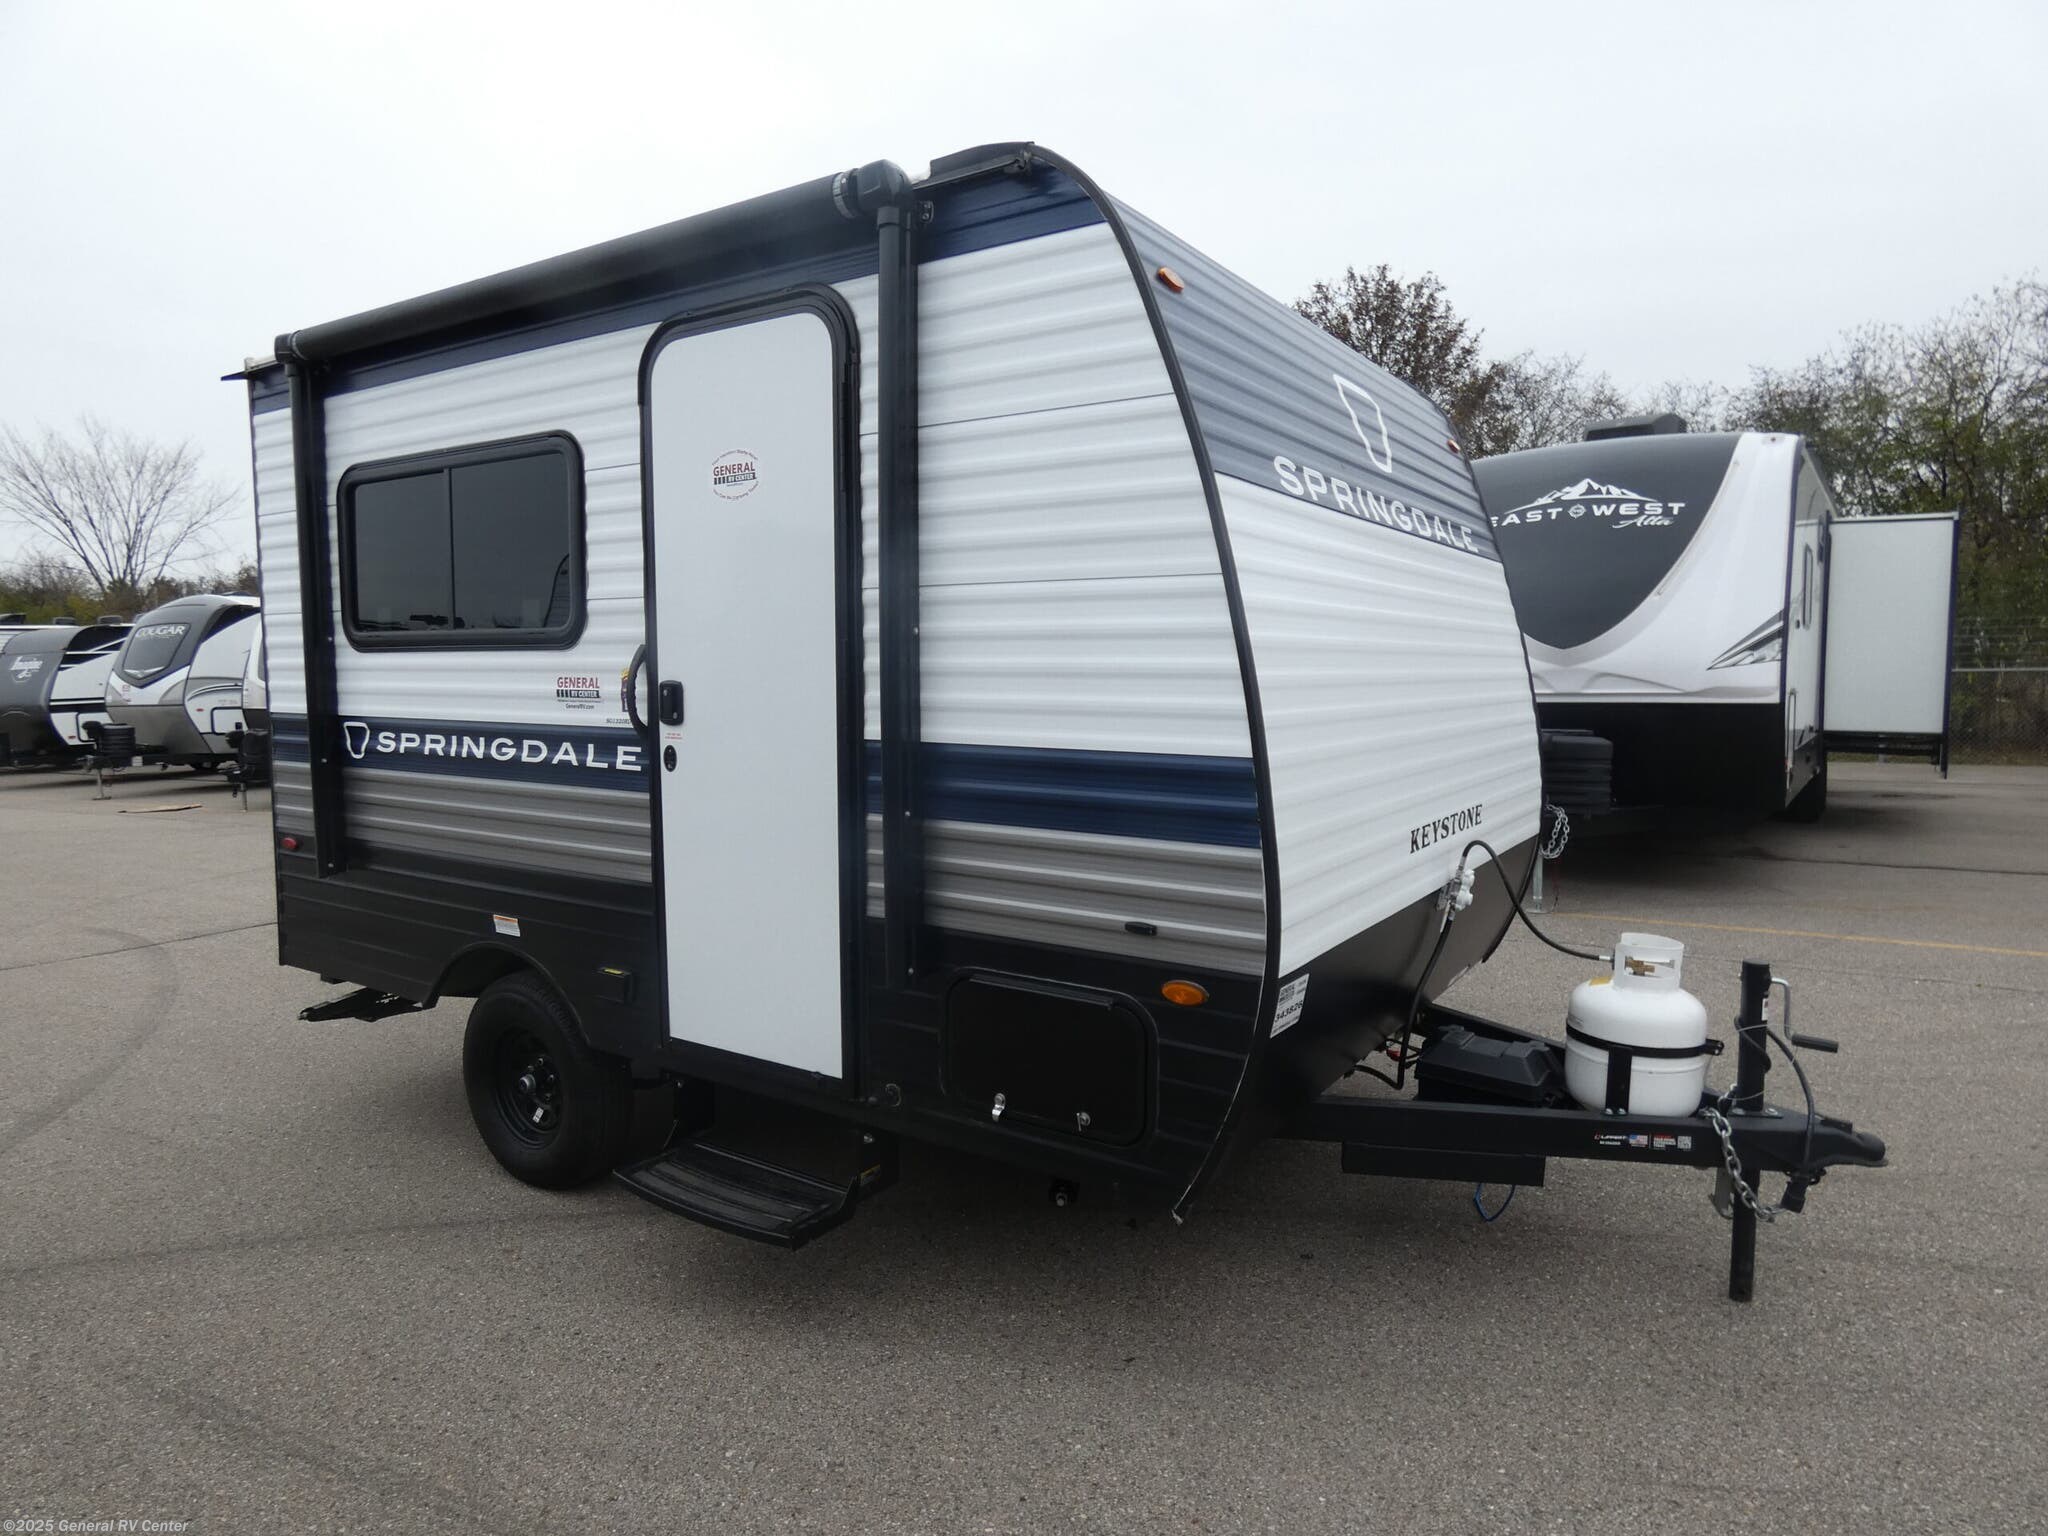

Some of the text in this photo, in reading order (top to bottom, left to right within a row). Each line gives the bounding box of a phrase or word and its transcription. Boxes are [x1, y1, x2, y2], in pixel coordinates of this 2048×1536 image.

[713, 461, 756, 477] GENERAL
[1273, 455, 1478, 553] SPRINGDALE
[1592, 502, 1686, 517] WEST
[135, 625, 186, 638] COUGAR
[557, 676, 600, 689] GENERAL
[375, 730, 643, 772] SPRINGDALE
[1410, 804, 1483, 854] KEYSTONE
